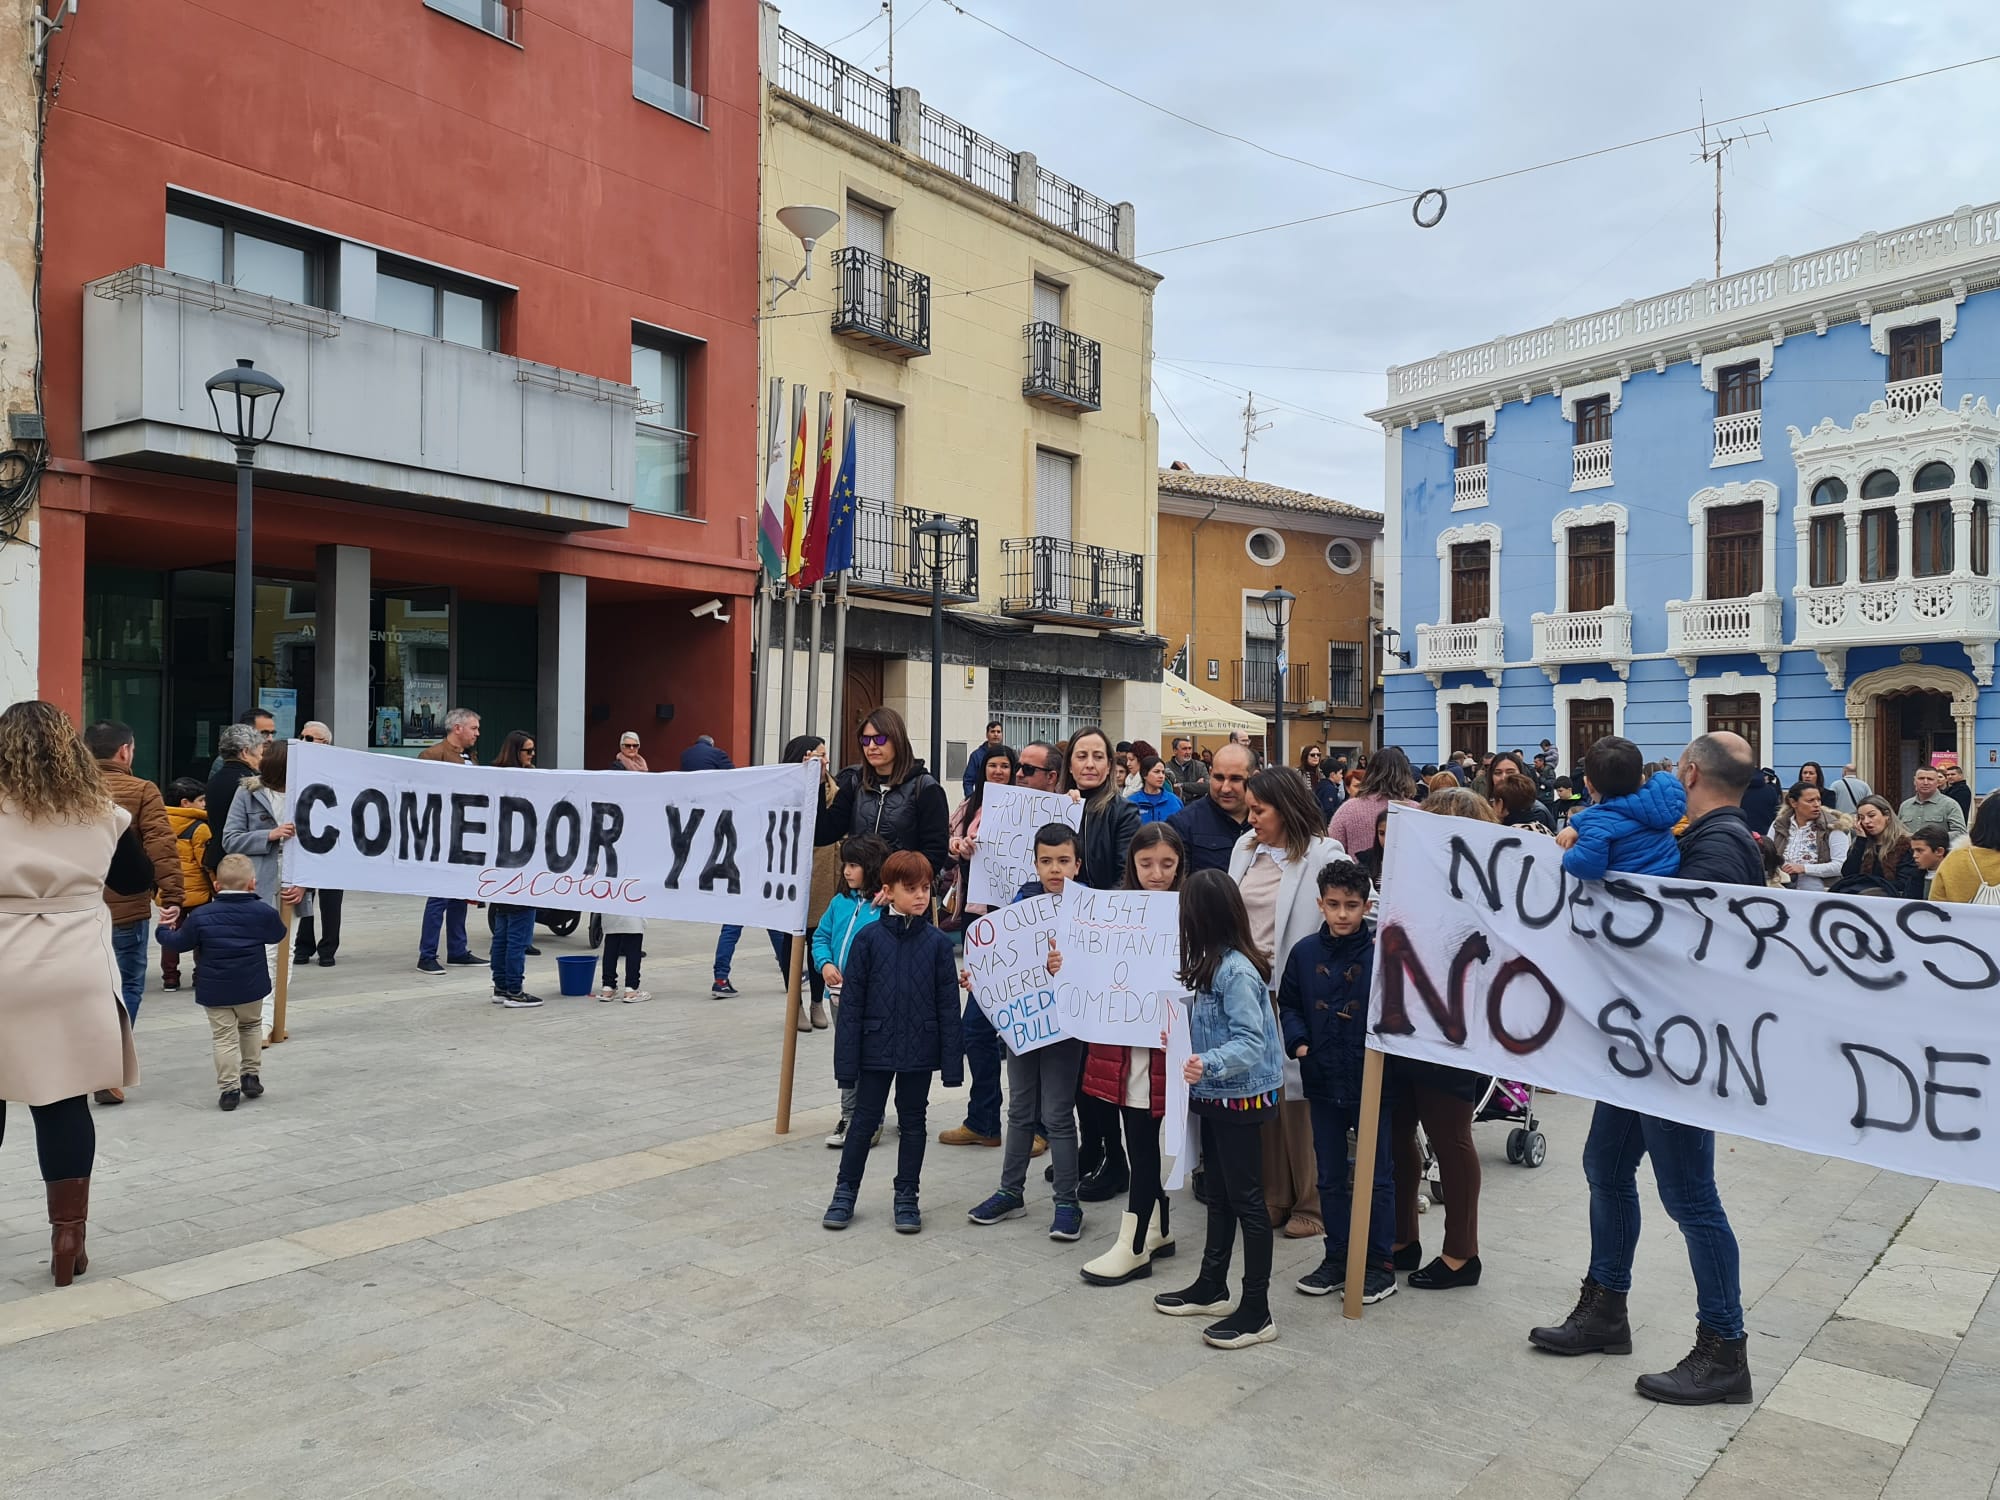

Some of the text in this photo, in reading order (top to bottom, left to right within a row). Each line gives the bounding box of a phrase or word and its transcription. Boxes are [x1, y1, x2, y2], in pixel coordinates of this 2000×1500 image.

[295, 782, 802, 902] COMEDOR YA !!!
[974, 827, 1034, 866] +HECH
[965, 894, 1063, 955] NO QUER
[1449, 835, 2000, 991] NUESTR@S
[969, 939, 1018, 981] MÁS
[1067, 922, 1180, 957] HABITANTE
[1012, 1014, 1061, 1049] BULL
[1373, 924, 1991, 1142] NO SON DE
